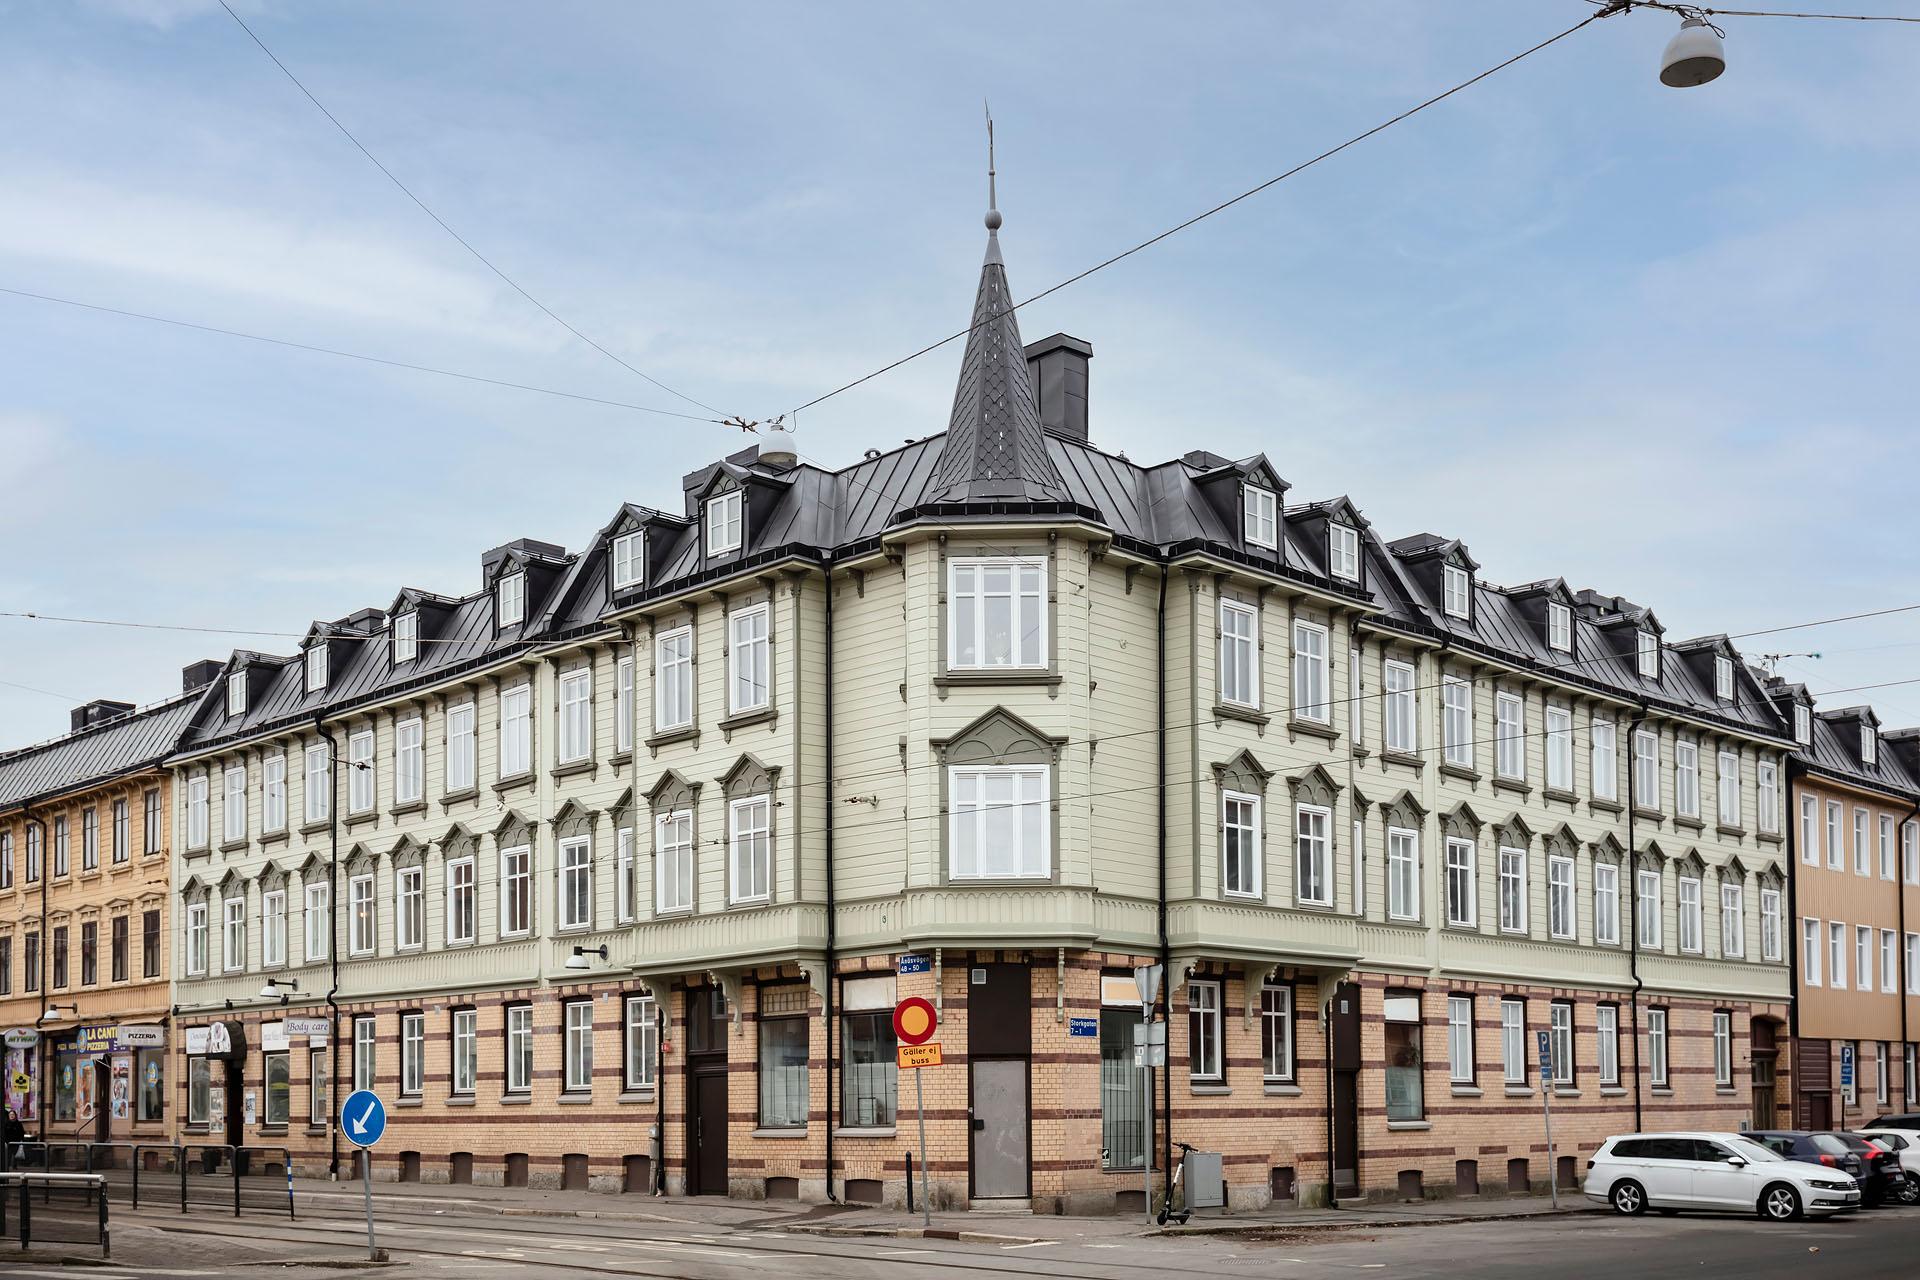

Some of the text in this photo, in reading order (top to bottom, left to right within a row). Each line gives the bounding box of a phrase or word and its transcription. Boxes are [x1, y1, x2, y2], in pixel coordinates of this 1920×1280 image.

[87, 1026, 118, 1040] LA CANTI
[288, 1022, 309, 1033] Body
[87, 1041, 109, 1050] PIZZERIA
[1541, 1033, 1547, 1051] P
[903, 1046, 936, 1056] Gäller ej
[1844, 1048, 1850, 1062] P
